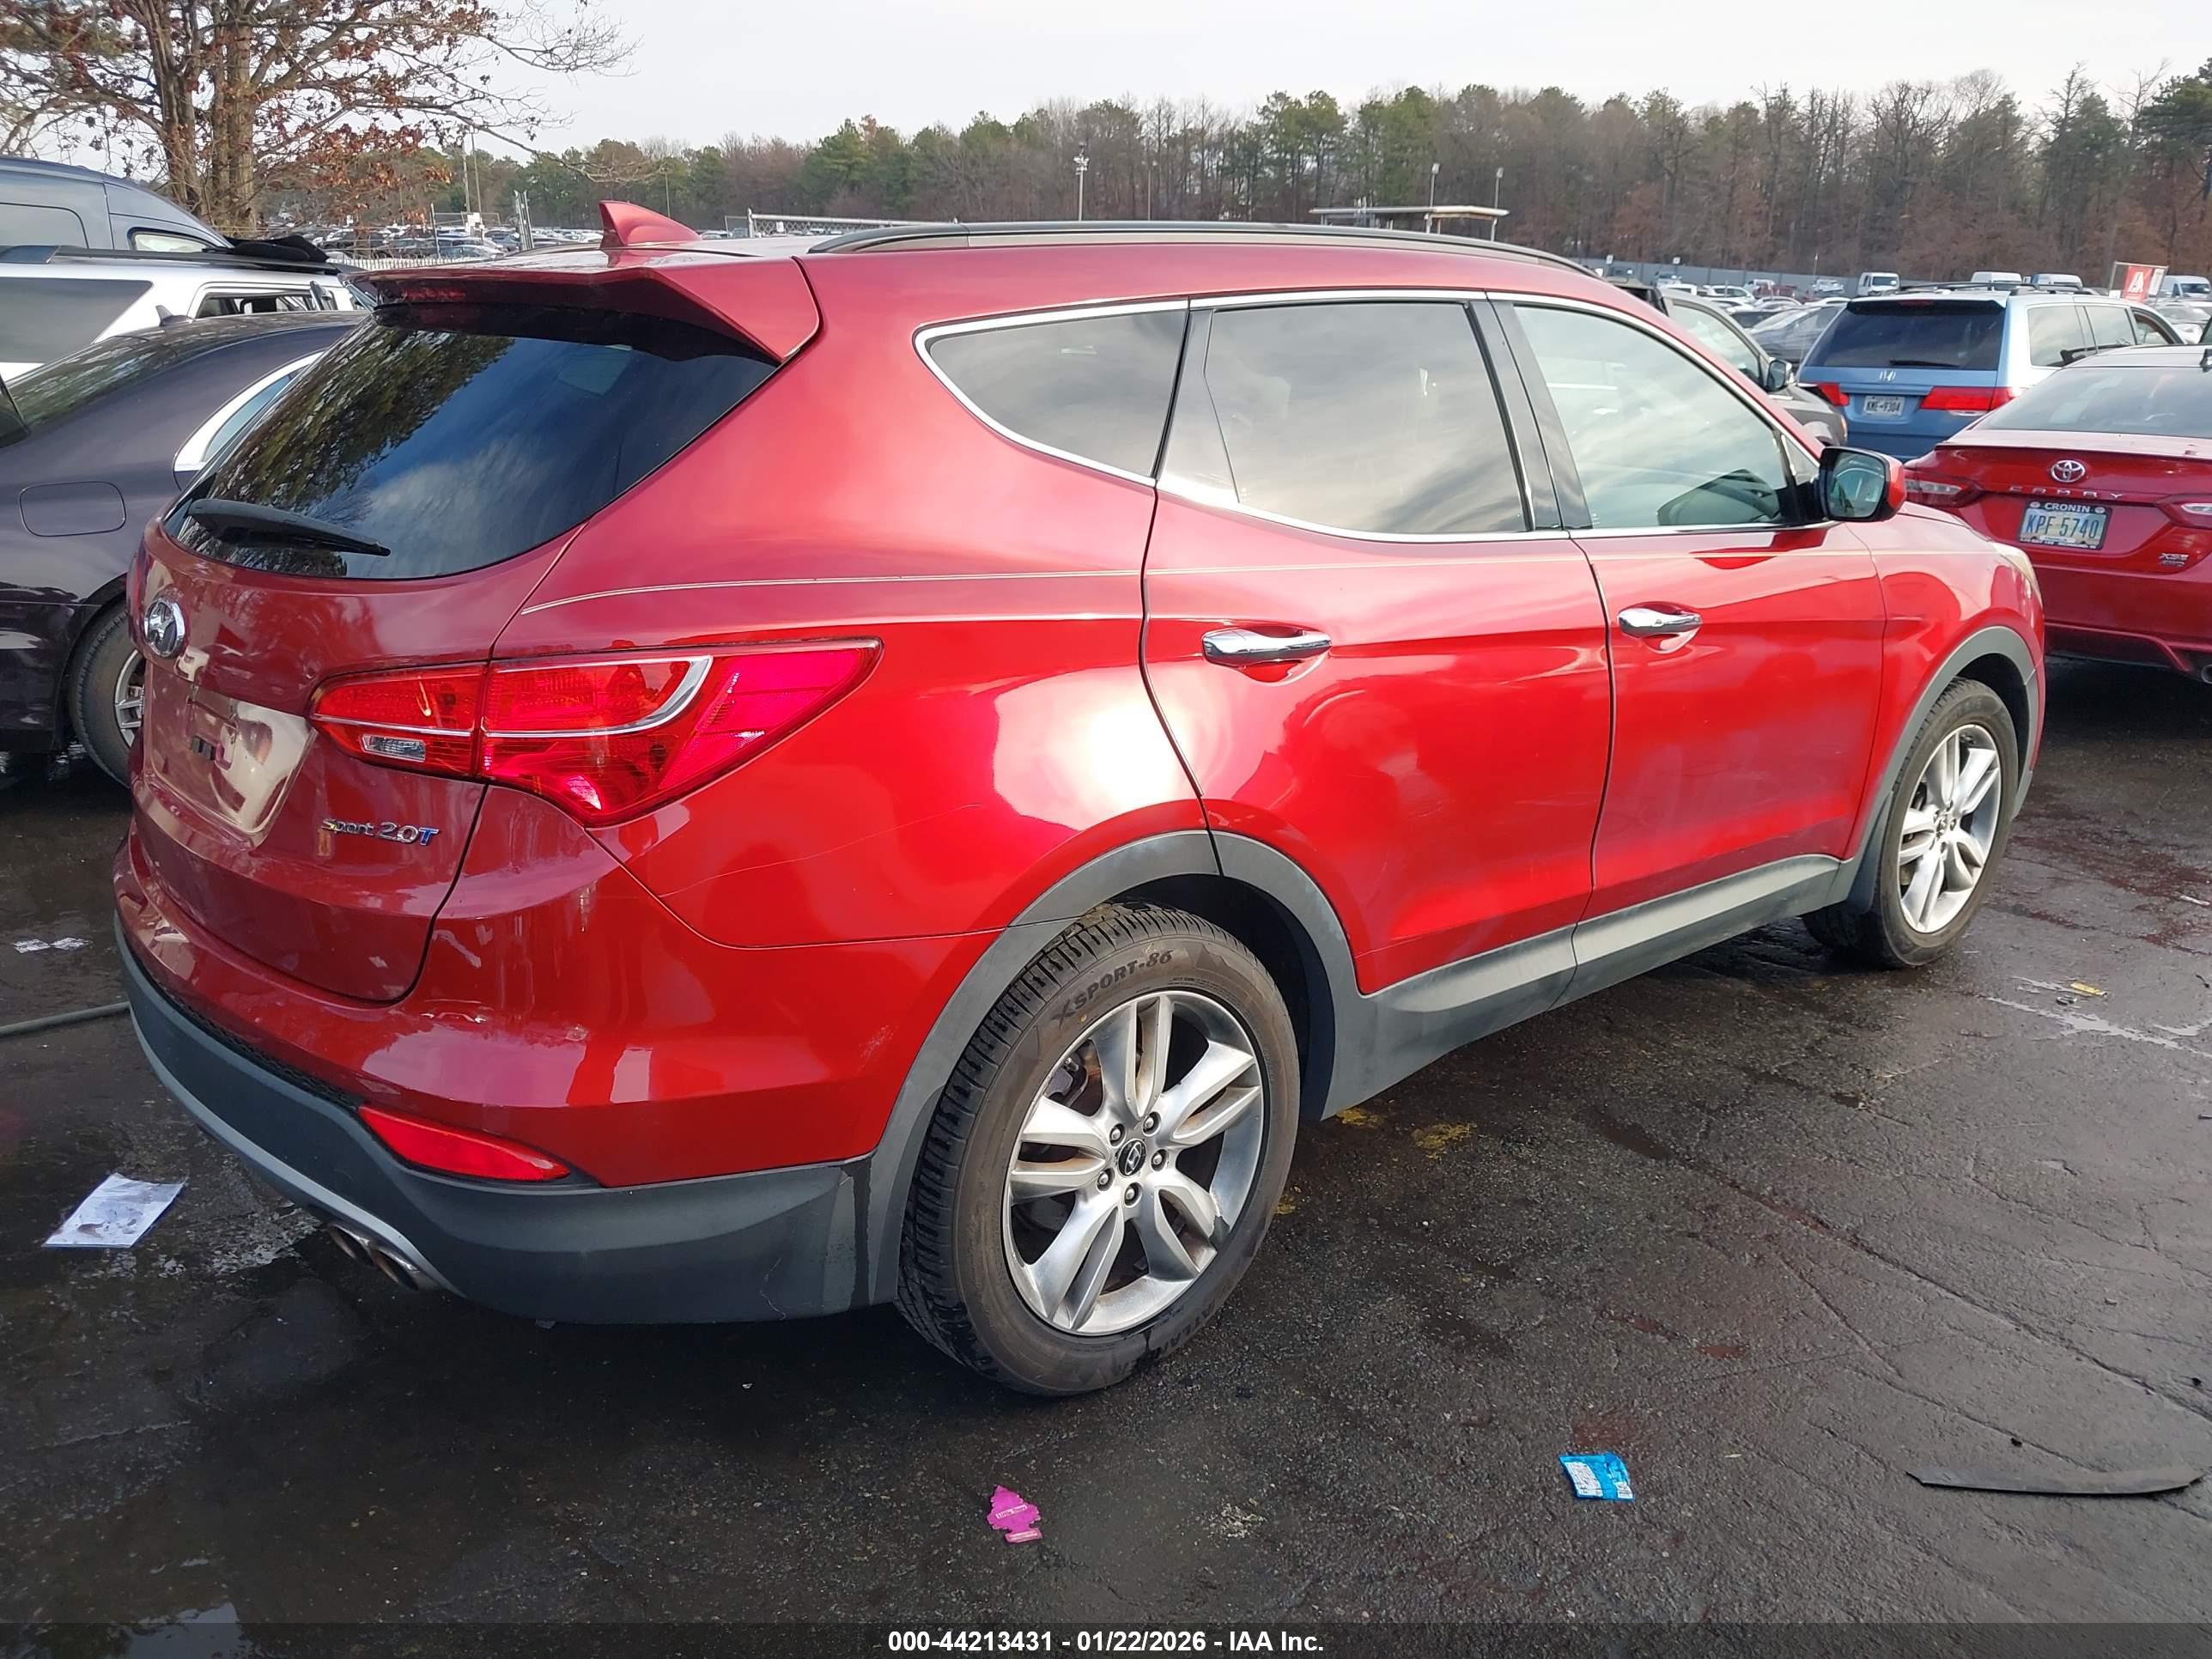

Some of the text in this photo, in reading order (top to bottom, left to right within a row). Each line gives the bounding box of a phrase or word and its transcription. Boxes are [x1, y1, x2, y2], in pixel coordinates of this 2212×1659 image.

[2044, 502, 2091, 513] CRONIN
[2026, 515, 2100, 539] KPF 5740
[321, 817, 374, 836] Sport
